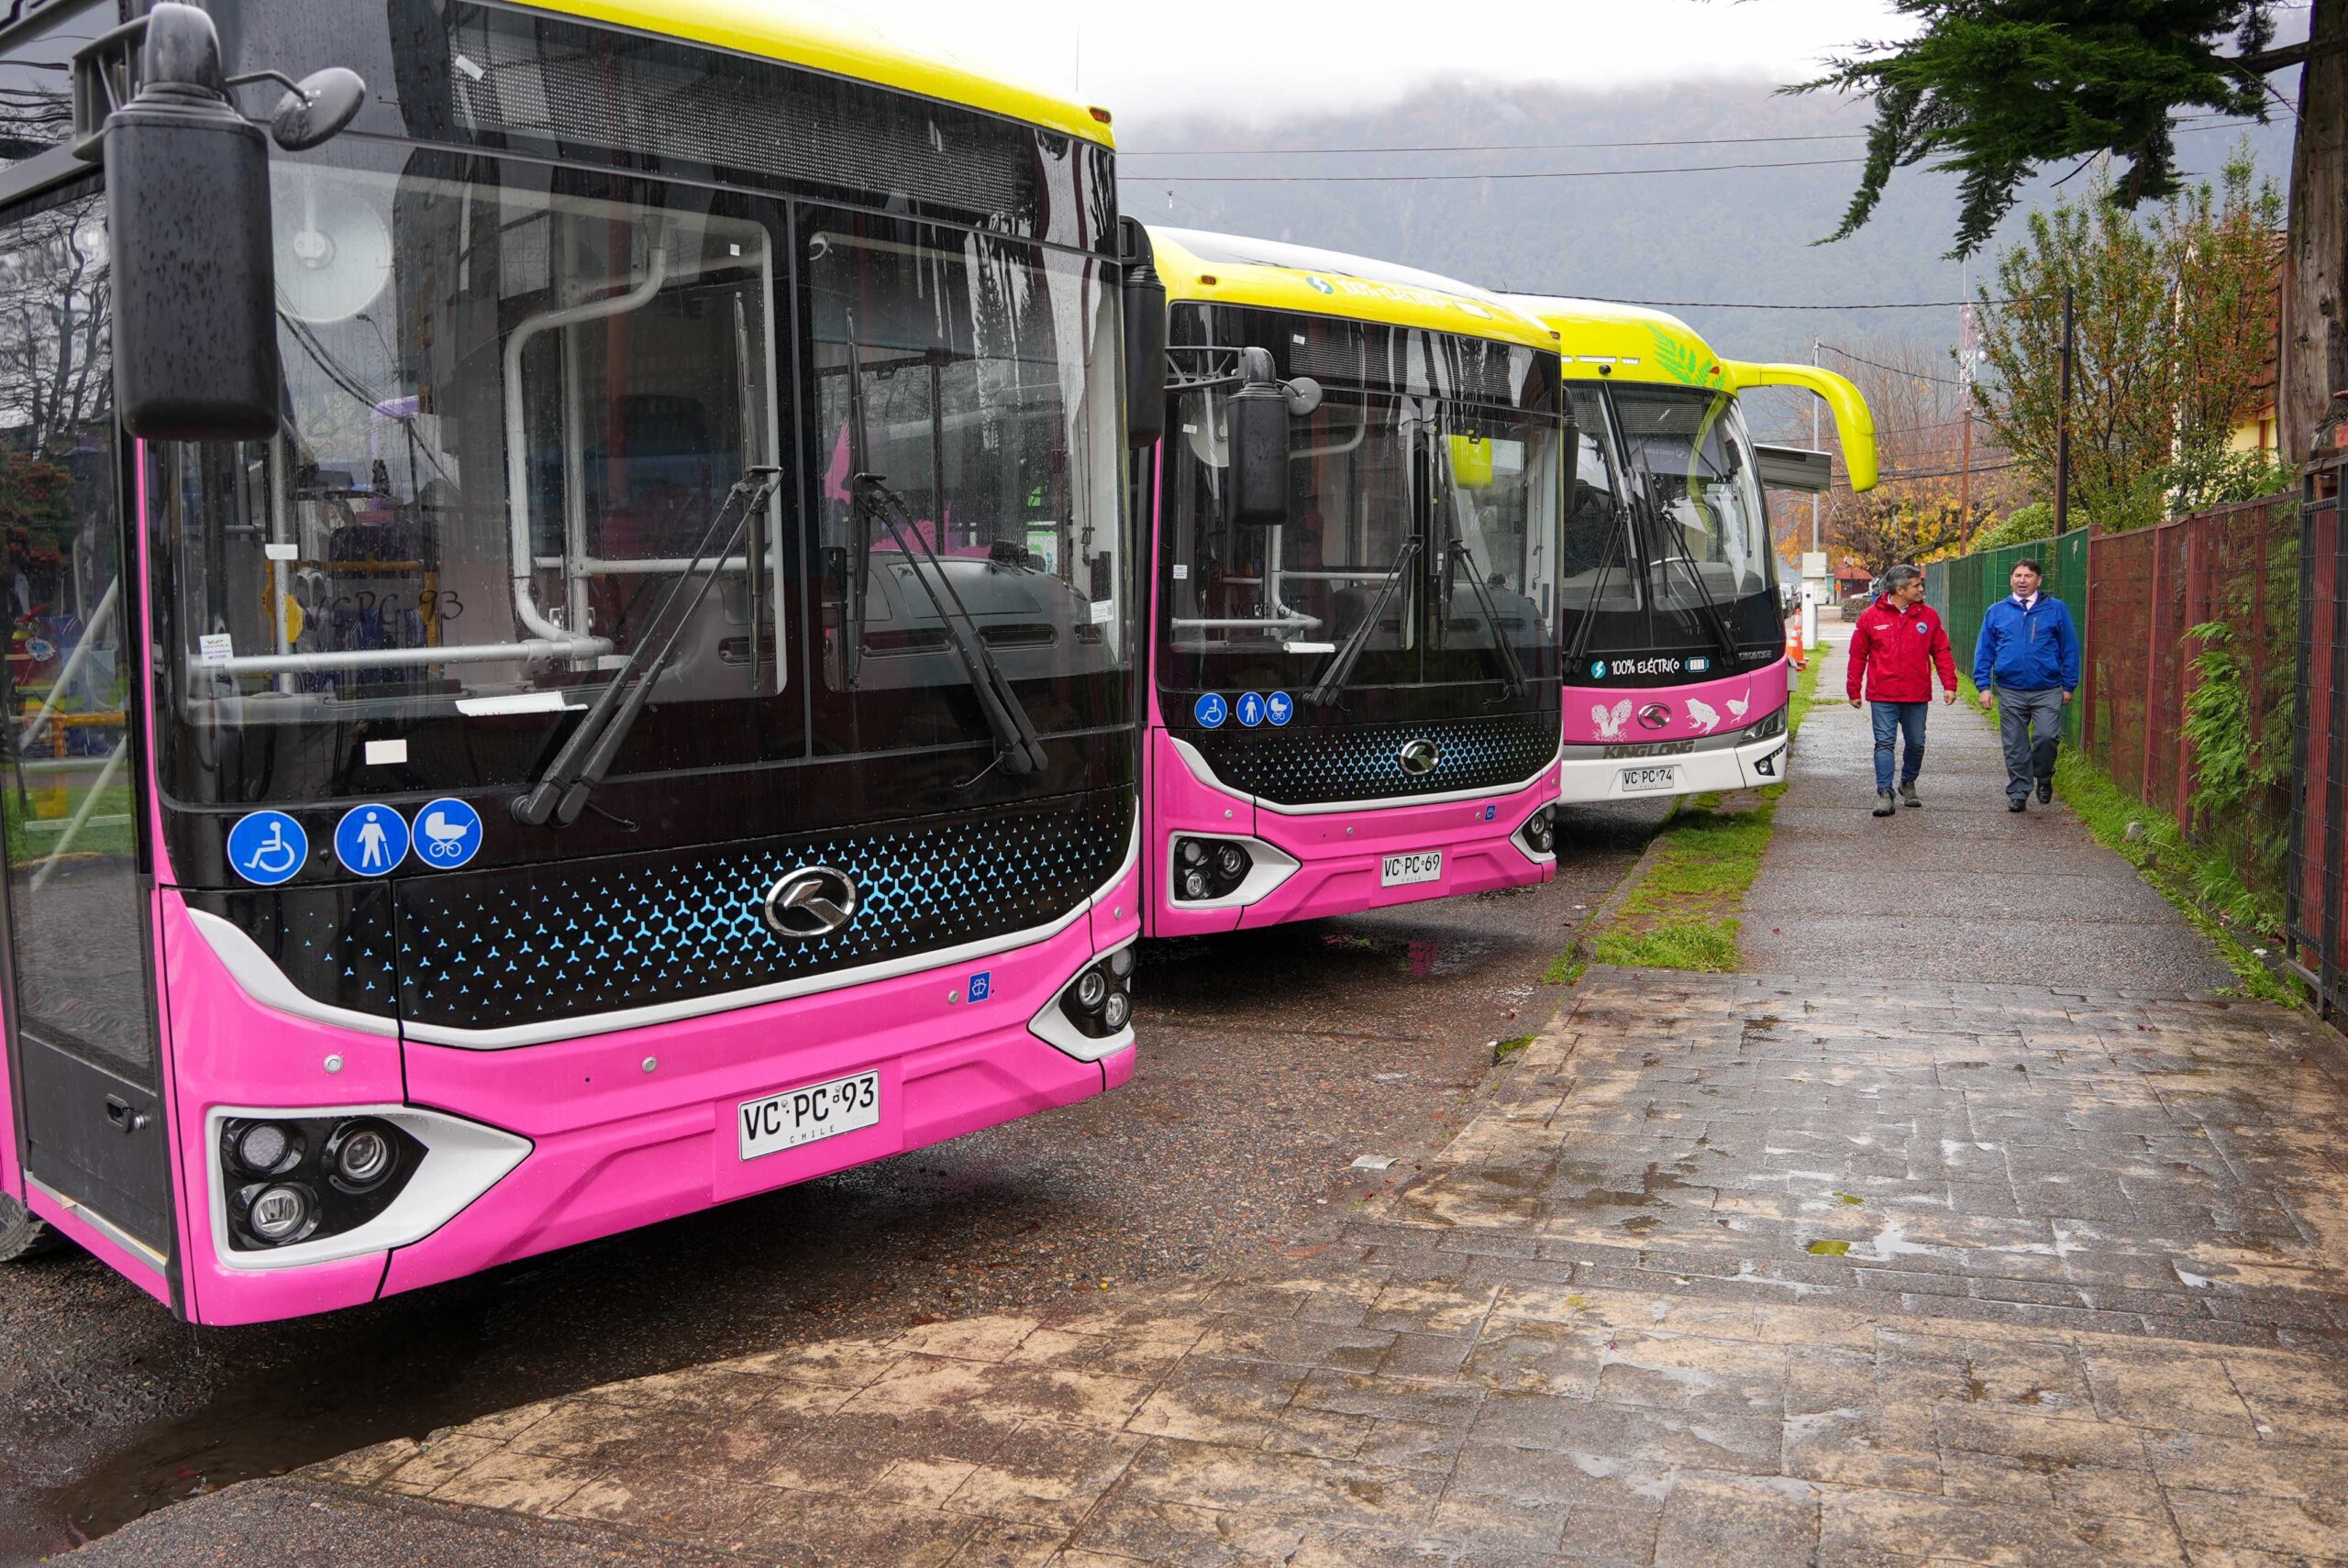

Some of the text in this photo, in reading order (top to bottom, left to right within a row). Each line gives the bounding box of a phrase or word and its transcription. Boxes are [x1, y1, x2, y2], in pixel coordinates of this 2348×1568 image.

[418, 590, 464, 621] 93
[1611, 657, 1680, 675] 100% ELÉCTRICO
[790, 1123, 836, 1144] CHILE
